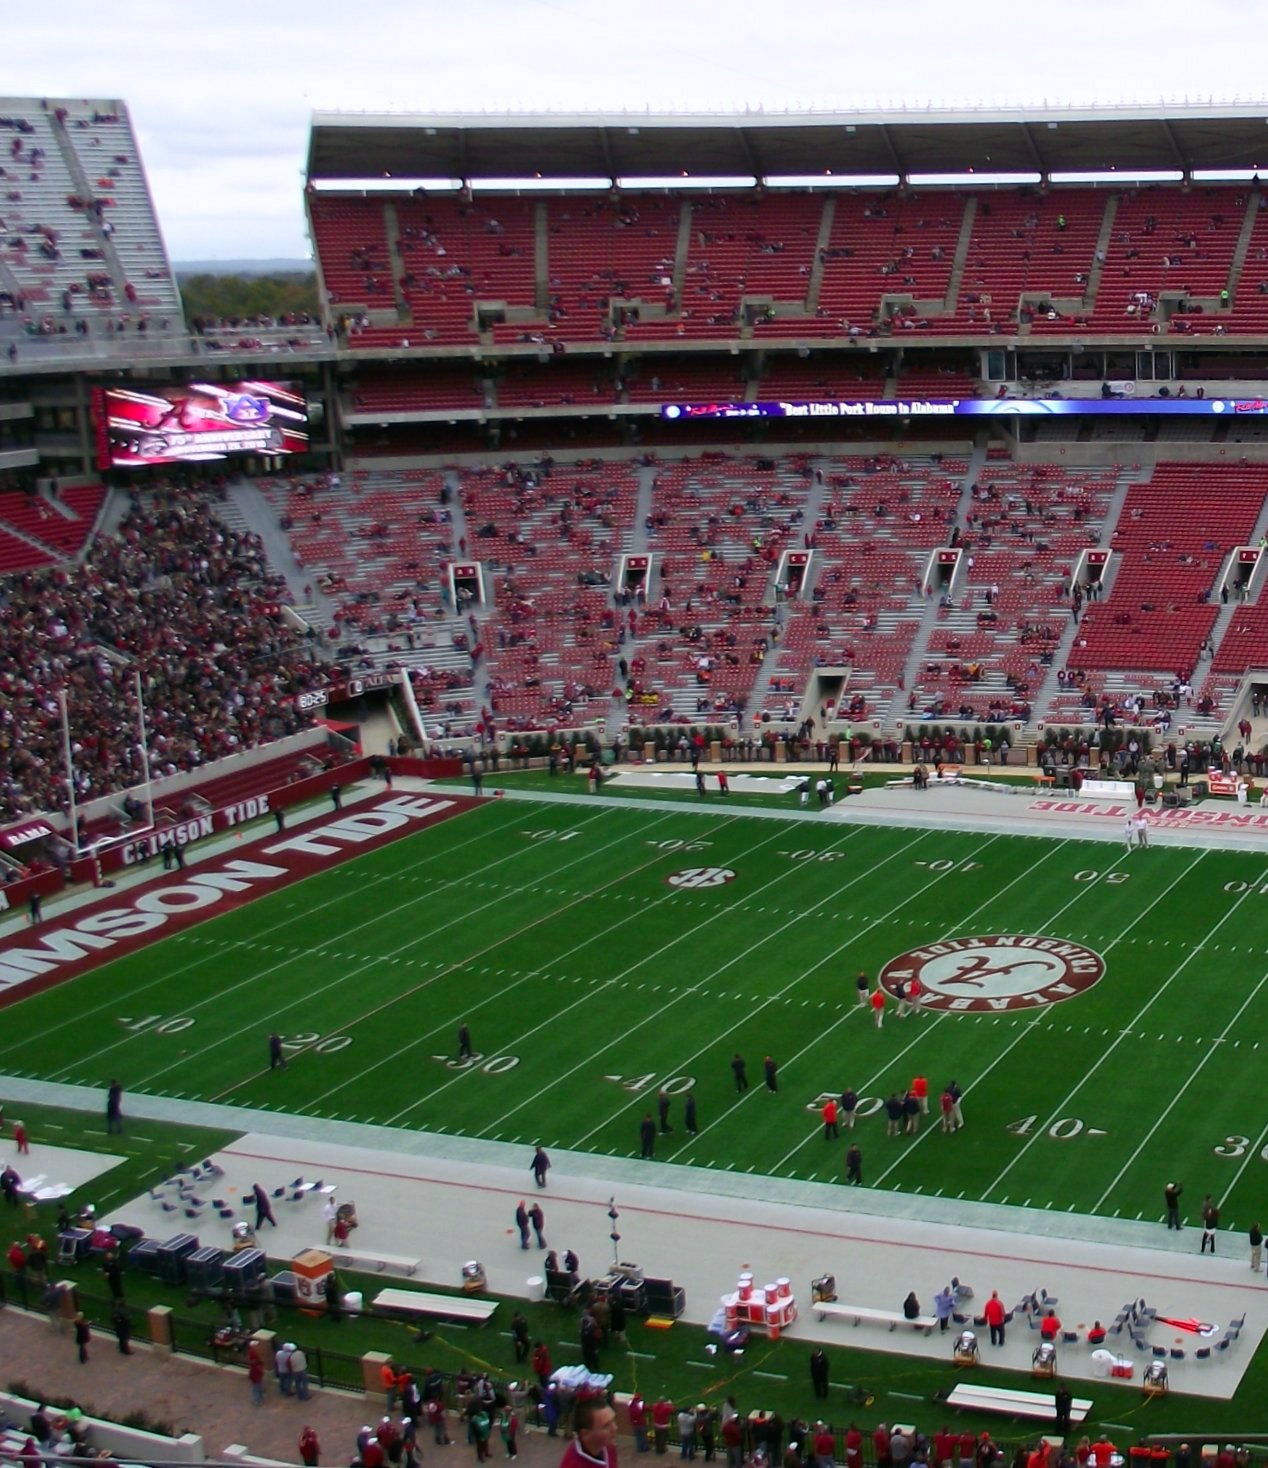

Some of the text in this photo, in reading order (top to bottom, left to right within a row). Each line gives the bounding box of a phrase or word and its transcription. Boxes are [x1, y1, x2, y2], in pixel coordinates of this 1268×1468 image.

[810, 403, 838, 415] Little
[840, 403, 865, 415] Pork
[866, 402, 897, 414] House
[224, 795, 269, 825] TIDE
[1029, 800, 1128, 817] TIDE
[7, 826, 51, 846] BAMA
[668, 867, 736, 888] SEC
[1073, 870, 1132, 884] 50
[0, 795, 458, 992] IMSON TIDE
[910, 936, 1098, 973] CRIMSON TIDE
[888, 968, 1077, 1009] ALABAA
[622, 1073, 696, 1095] 40
[1005, 1114, 1085, 1139] 40
